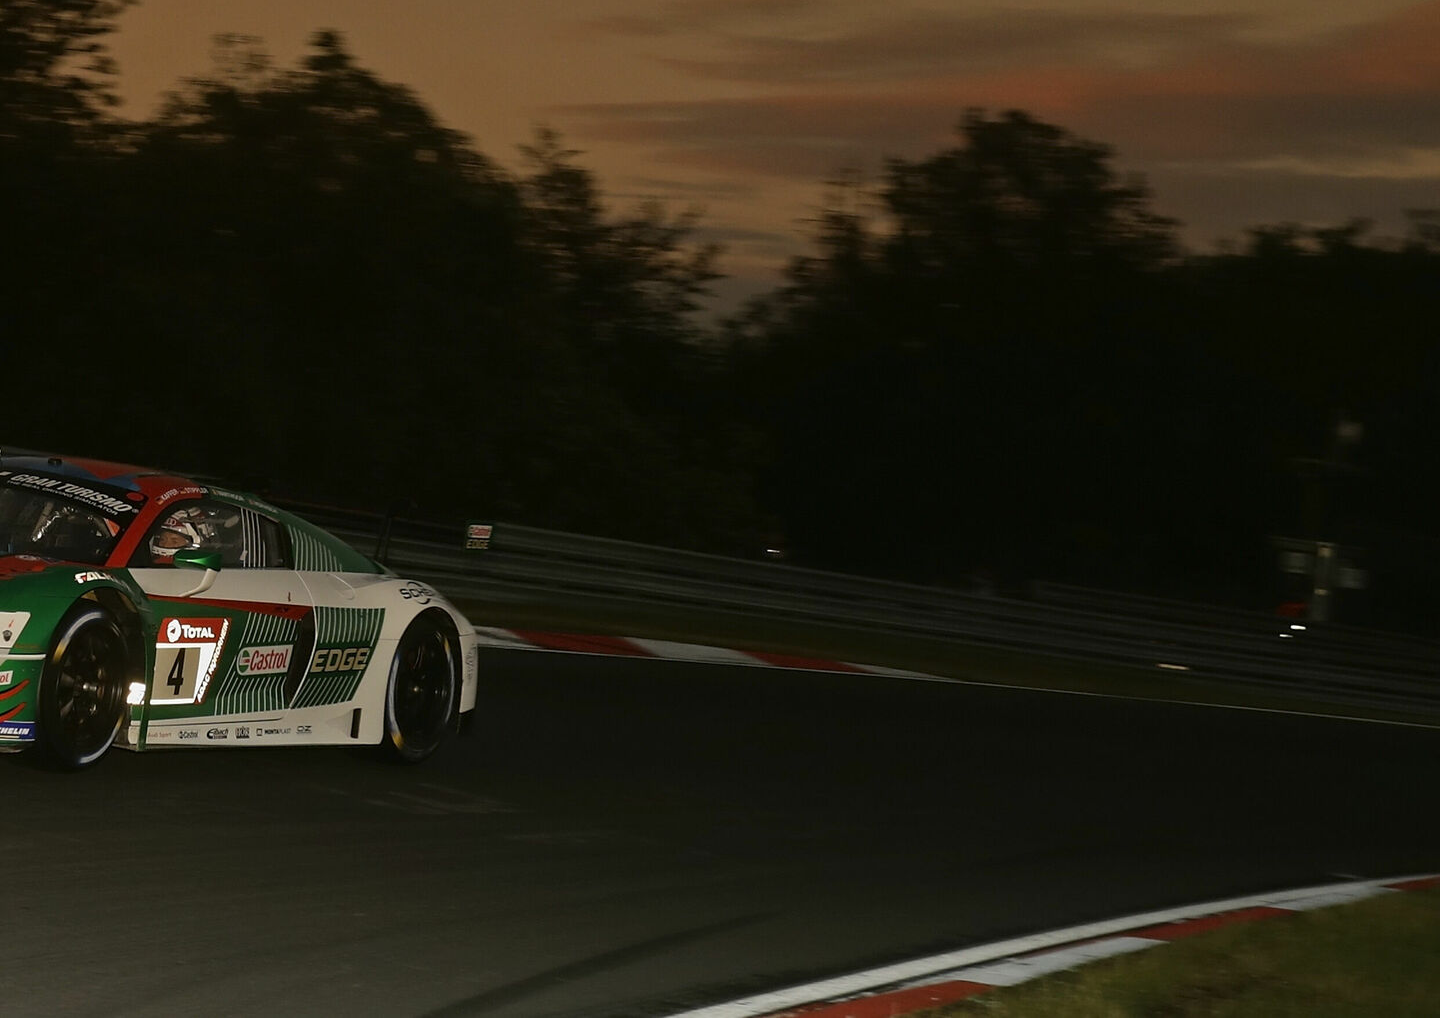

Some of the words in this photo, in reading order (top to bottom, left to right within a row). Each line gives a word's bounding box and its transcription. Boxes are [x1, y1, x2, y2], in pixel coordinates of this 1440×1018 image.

[10, 473, 61, 487] GRAN
[57, 483, 133, 513] TURISMO
[181, 624, 215, 639] TOTAL
[167, 648, 186, 695] 4
[250, 649, 289, 671] Castrol
[311, 647, 371, 674] EDGE
[197, 673, 211, 703] ADAC
